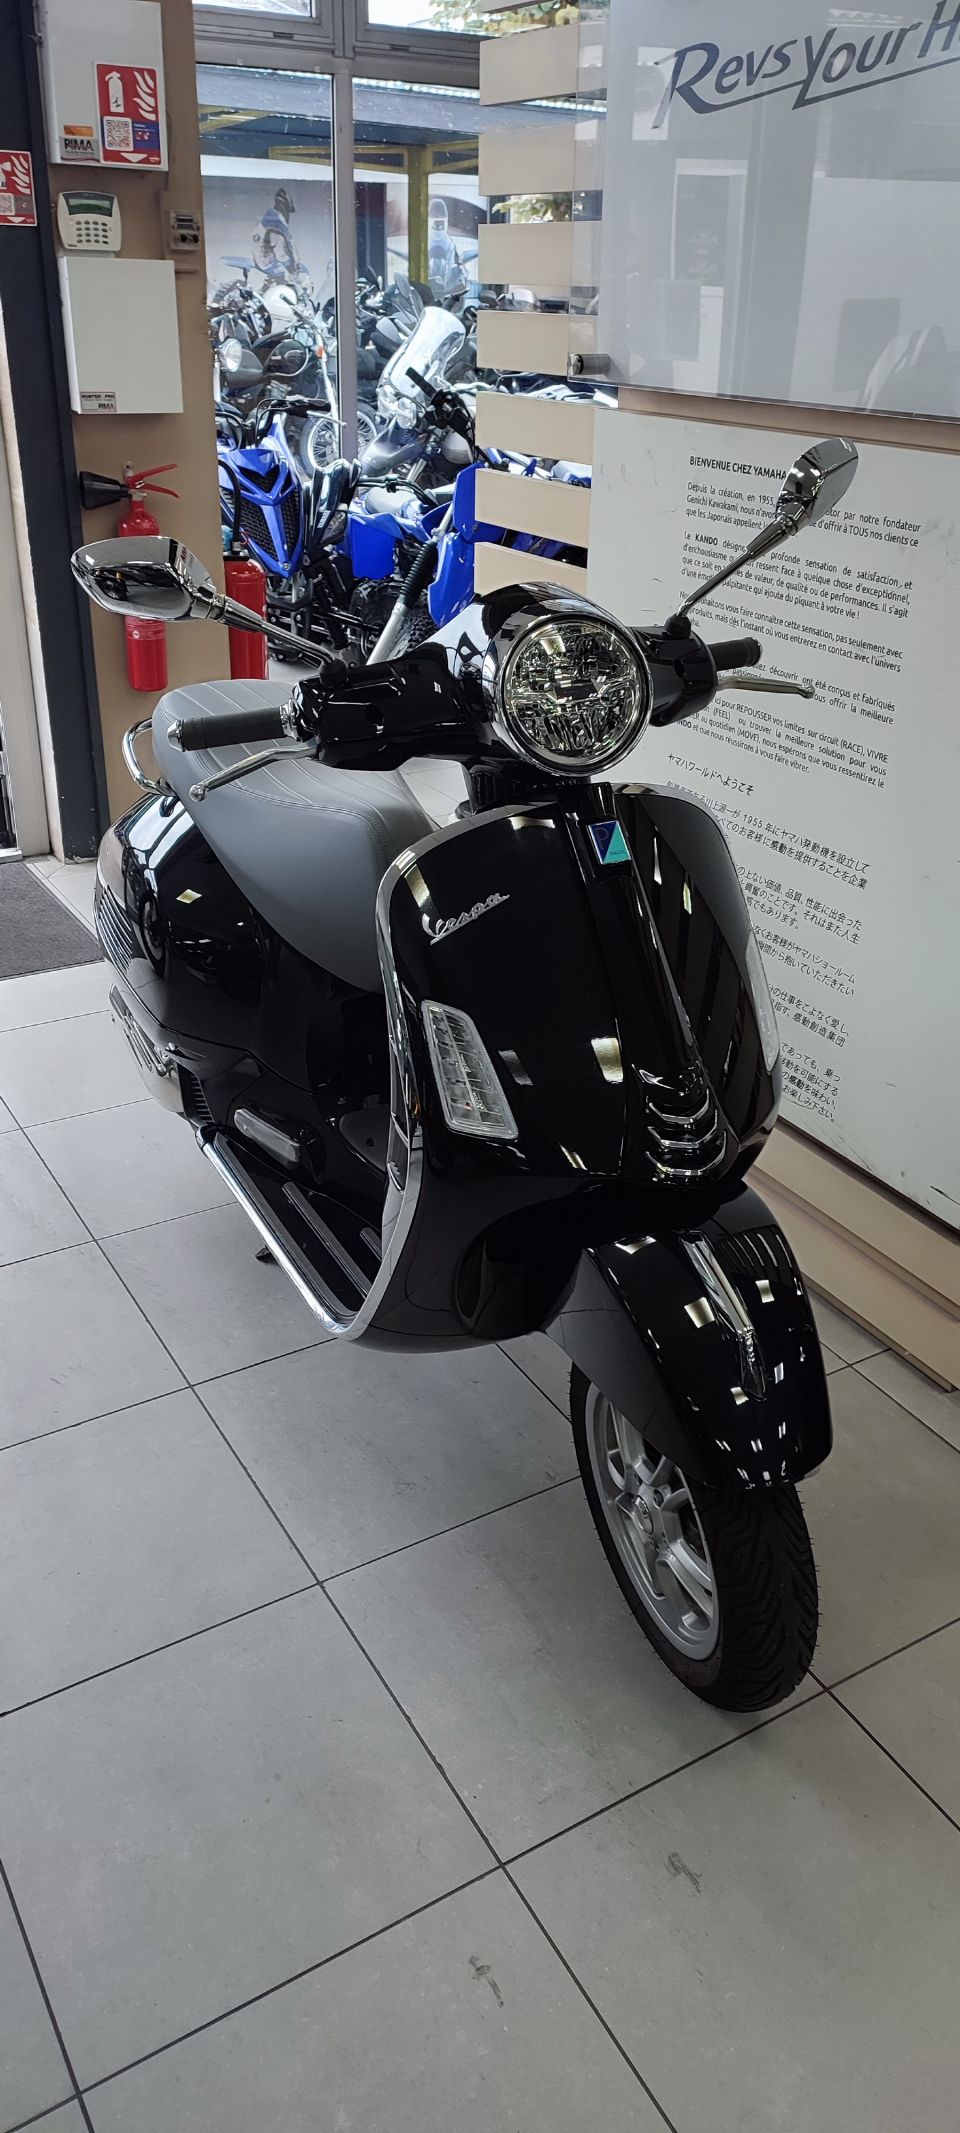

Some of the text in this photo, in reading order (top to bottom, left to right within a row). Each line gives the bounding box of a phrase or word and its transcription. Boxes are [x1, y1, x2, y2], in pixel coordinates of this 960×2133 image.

[652, 0, 960, 129] Revs Your H
[64, 138, 94, 152] PIMA
[690, 456, 787, 480] BIENVENUE CHEZ YAMAHA
[686, 508, 697, 518] que
[697, 508, 706, 519] les
[707, 511, 732, 524] Japonais
[733, 516, 762, 529] appellent
[687, 495, 708, 506] Genichi
[708, 499, 739, 513] Kawakami,
[740, 507, 754, 516] nous
[818, 520, 842, 532] d'offrir
[843, 524, 847, 533] à
[849, 524, 868, 538] TOUS
[870, 531, 882, 540] nos
[884, 532, 909, 546] clients
[910, 538, 919, 547] ce
[688, 482, 707, 493] Depuis
[710, 485, 716, 494] la
[718, 488, 744, 501] création,
[747, 494, 755, 502] en
[759, 494, 776, 507] 1955,
[844, 512, 856, 521] par
[860, 514, 879, 525] notre
[883, 516, 921, 532] fondateur
[683, 543, 727, 561] d'enthousiasme
[756, 561, 779, 574] ressent
[781, 565, 795, 576] face
[797, 568, 801, 578] à
[804, 572, 830, 585] quelque
[833, 578, 853, 590] chose
[856, 583, 910, 606] d'exceptionnel,
[684, 531, 691, 540] Le
[695, 533, 718, 546] KANDO
[770, 552, 801, 564] profonde
[805, 559, 837, 573] sensation
[843, 566, 852, 576] de
[904, 580, 913, 590] et
[682, 568, 697, 577] d'une
[722, 580, 752, 592] palpitante
[753, 586, 763, 595] qui
[764, 588, 784, 598] ajoute
[785, 593, 793, 602] du
[794, 596, 819, 609] piquant
[821, 602, 824, 610] à
[826, 604, 844, 615] votre
[846, 609, 855, 618] vie
[683, 557, 693, 566] que
[702, 559, 714, 569] soit
[745, 570, 753, 579] de
[754, 574, 774, 586] valeur,
[776, 578, 784, 588] de
[786, 581, 808, 592] qualité
[810, 587, 818, 596] ou
[820, 588, 828, 598] de
[830, 593, 880, 611] performances.
[882, 603, 886, 612] Il
[888, 604, 908, 618] s'agit
[715, 614, 728, 622] mais
[729, 616, 739, 626] dès
[740, 619, 764, 634] l'instant
[766, 626, 773, 636] où
[774, 631, 788, 641] vous
[790, 634, 817, 648] entrerez
[819, 643, 826, 651] en
[828, 645, 853, 659] contact
[854, 652, 870, 663] avec
[871, 655, 901, 673] l'univers
[726, 604, 903, 659] vous faire connaître cette sensation, pas seulement avec
[770, 665, 798, 681] découvrir
[815, 680, 826, 690] été
[828, 685, 850, 698] conçus
[853, 692, 860, 700] et
[862, 693, 896, 712] fabriqués
[812, 693, 894, 724] ous offrir la meilleure
[693, 723, 698, 732] et
[700, 726, 710, 736] que
[710, 731, 724, 741] nous
[725, 736, 754, 753] réussirons
[755, 746, 759, 754] à
[760, 750, 774, 760] vous
[774, 753, 788, 766] faire
[790, 759, 810, 773] vibrer.
[709, 718, 735, 734] quotidien
[737, 728, 761, 744] (MOVE),
[762, 738, 777, 749] nous
[779, 743, 806, 760] espérons
[808, 754, 820, 765] que
[822, 759, 837, 771] vous
[838, 766, 876, 786] ressentirez
[878, 778, 885, 789] le
[714, 707, 730, 721] (FEEL)
[739, 718, 746, 726] ou
[750, 721, 772, 735] trouver
[776, 728, 781, 738] la
[785, 734, 814, 750] meilleure
[818, 745, 845, 761] solution
[849, 757, 866, 769] pour
[870, 764, 887, 776] vous
[722, 700, 736, 710] pour
[737, 703, 771, 722] REPOUSSER
[773, 717, 783, 727] vos
[784, 719, 805, 734] limites
[807, 729, 818, 739] sur
[819, 732, 839, 746] circuit
[841, 739, 865, 756] (RACE),
[867, 748, 888, 764] VIVRE
[668, 753, 754, 796] ヤマハワールドへようこそ
[743, 814, 763, 829] 1955
[422, 892, 510, 946] Vespa
